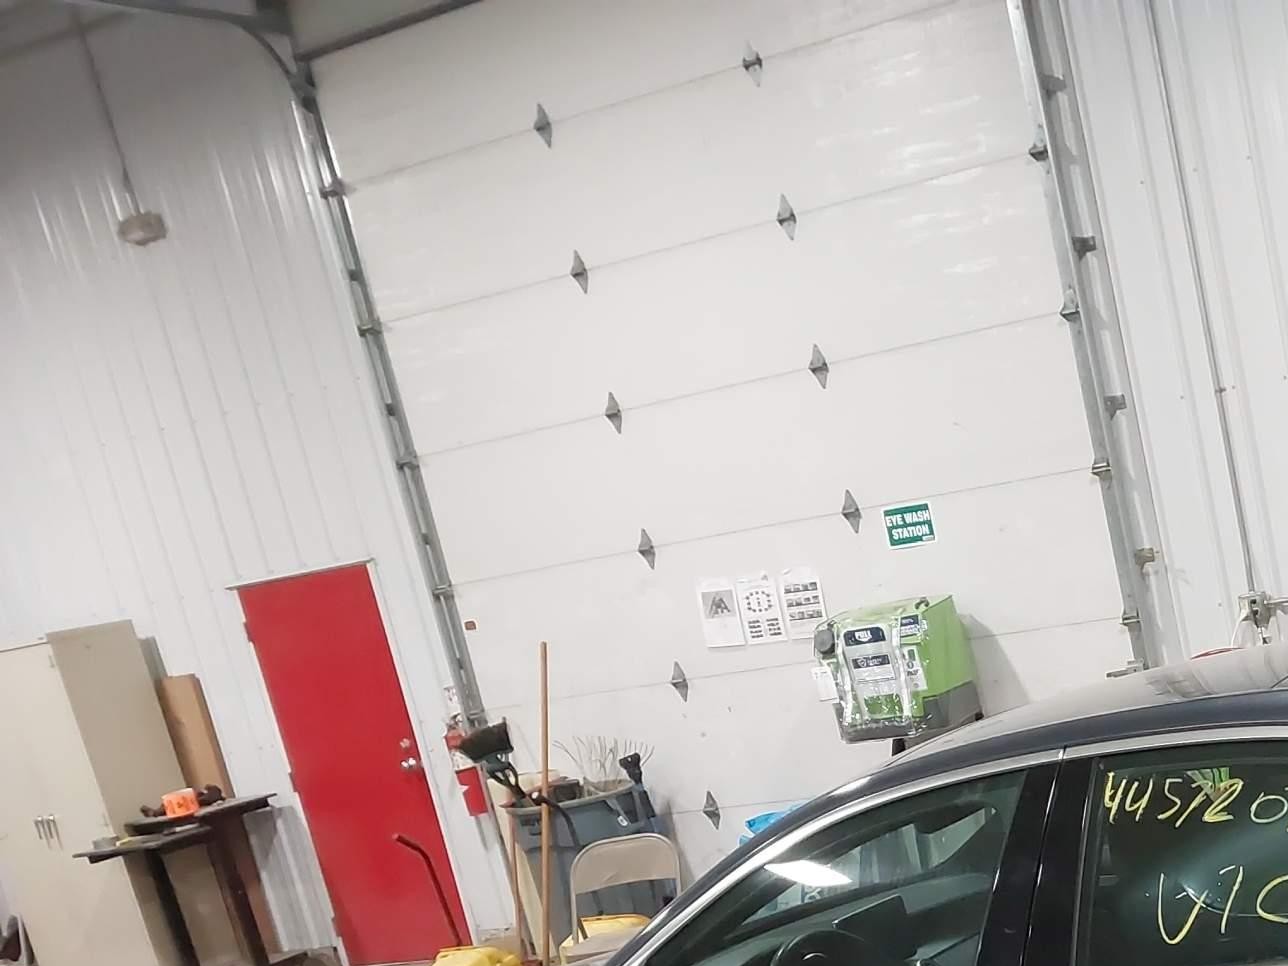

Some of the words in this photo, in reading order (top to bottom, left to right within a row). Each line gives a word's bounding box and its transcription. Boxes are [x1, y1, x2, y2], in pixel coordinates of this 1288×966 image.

[885, 514, 904, 527] EYE
[903, 509, 931, 524] WASH
[891, 524, 930, 540] STATION
